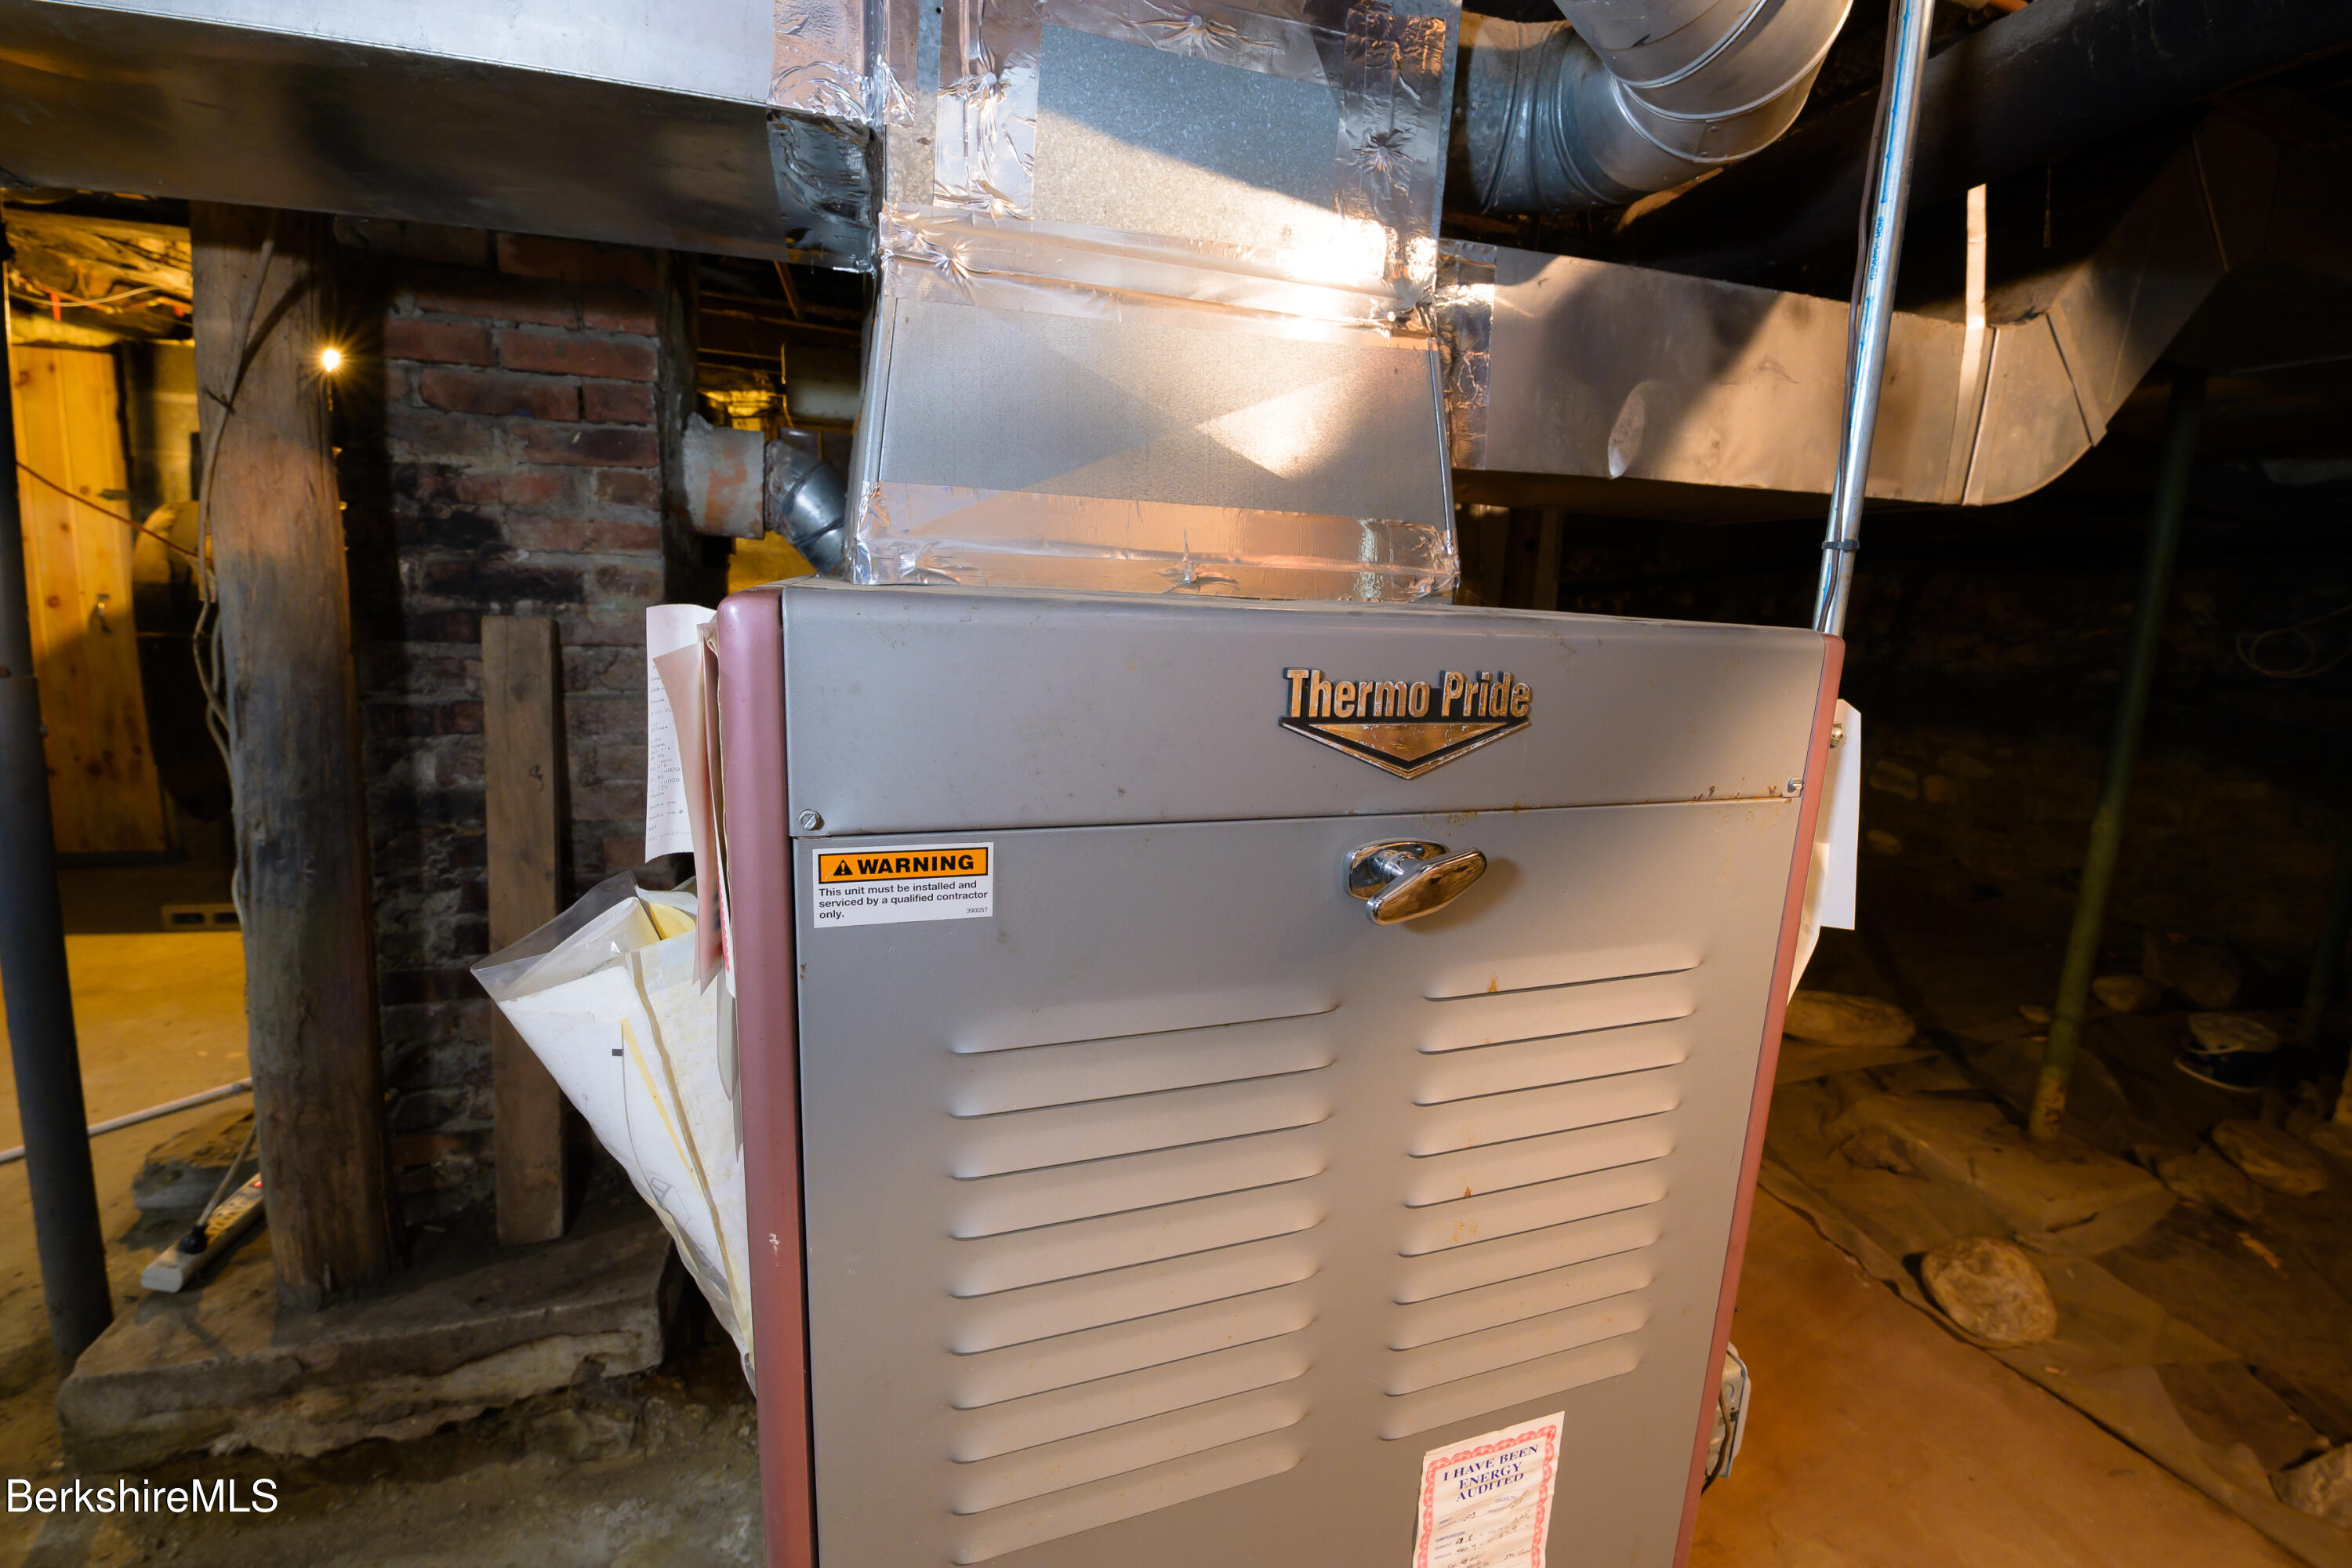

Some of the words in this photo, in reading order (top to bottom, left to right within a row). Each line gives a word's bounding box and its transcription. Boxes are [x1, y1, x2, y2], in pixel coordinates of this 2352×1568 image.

[1283, 667, 1431, 719] Thermo
[1439, 669, 1533, 718] Pride
[857, 855, 974, 875] WARNING
[818, 887, 841, 897] This
[844, 886, 865, 895] unit
[868, 884, 894, 894] must
[897, 884, 909, 892] be
[913, 881, 956, 891] installed
[958, 880, 977, 889] and
[818, 897, 863, 908] serviced
[866, 896, 879, 906] by
[891, 893, 934, 905] qualified
[936, 891, 988, 901] contractor
[819, 910, 844, 920] only.
[1443, 1472, 1449, 1482] I
[1454, 1457, 1495, 1479] HAVE
[1499, 1444, 1538, 1465] BEEN
[1456, 1473, 1524, 1502] AUDITED
[1459, 1461, 1523, 1490] ENERGY
